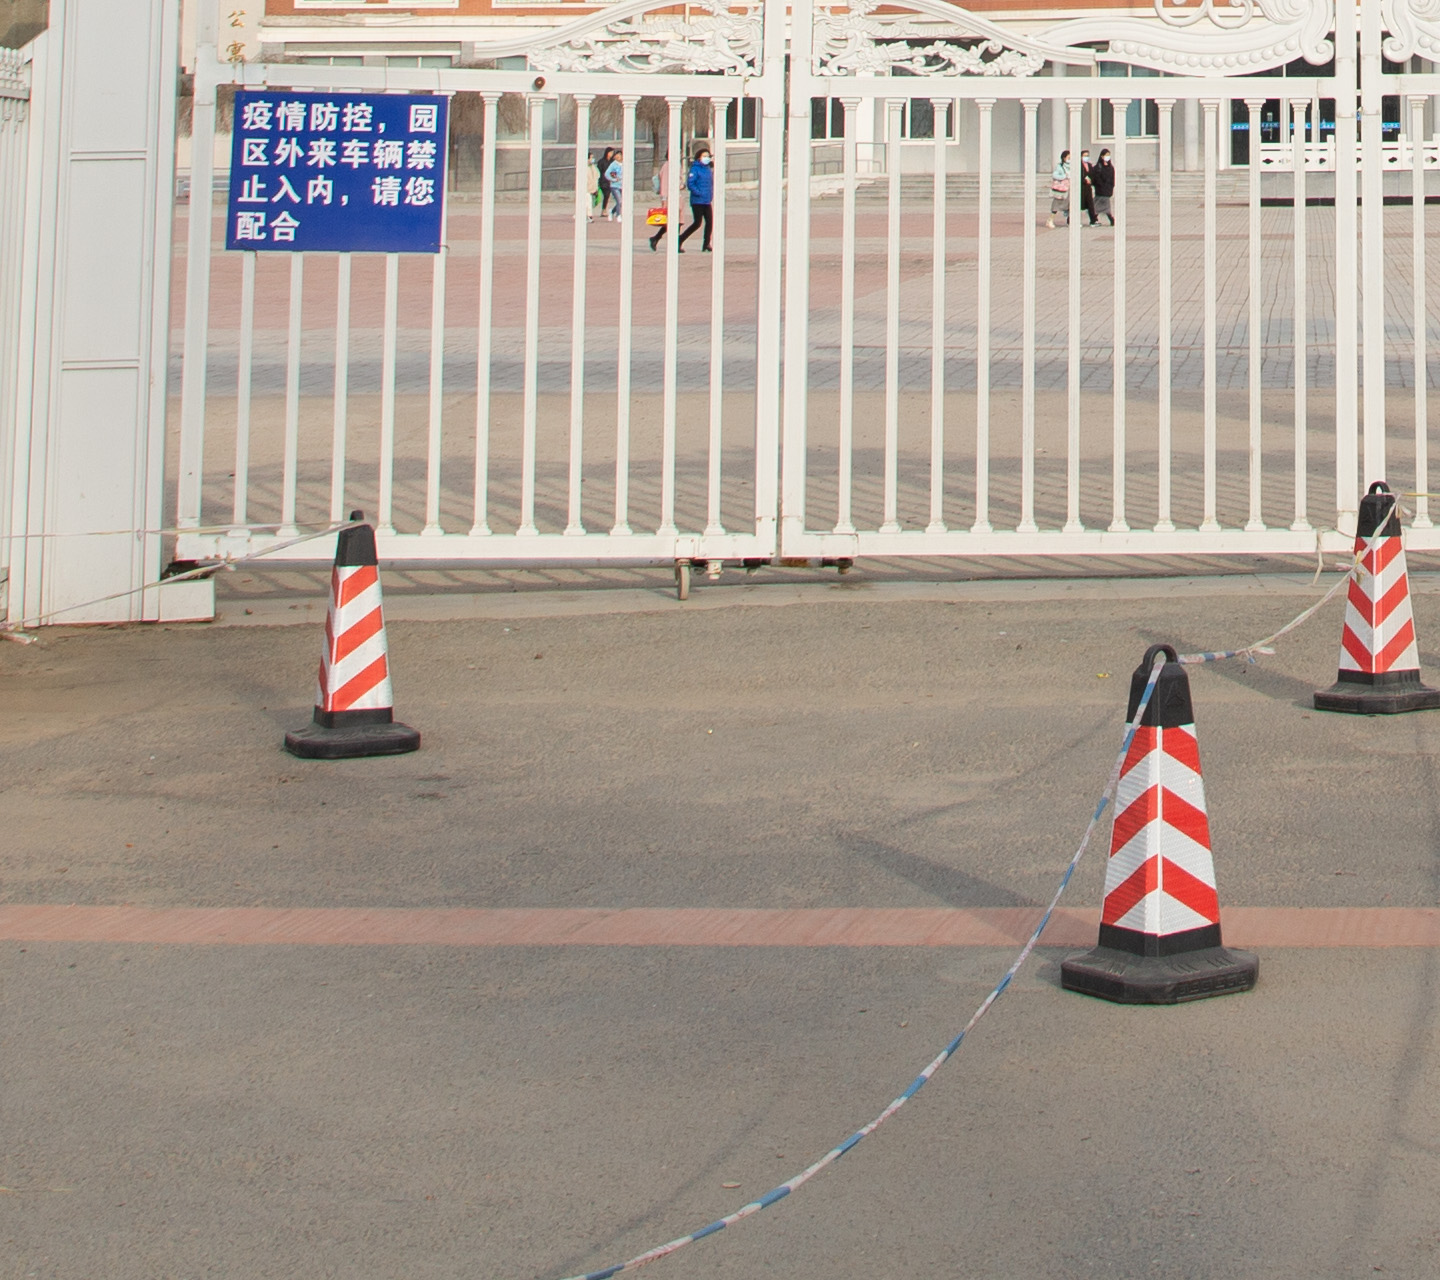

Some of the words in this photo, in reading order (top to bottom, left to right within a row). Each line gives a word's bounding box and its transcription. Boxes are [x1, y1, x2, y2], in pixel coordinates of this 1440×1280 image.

[242, 101, 438, 134] 疫情防控，园
[242, 137, 437, 168] 区外来车辆禁
[237, 173, 435, 208] 止入内，请您
[235, 212, 301, 241] 配合
